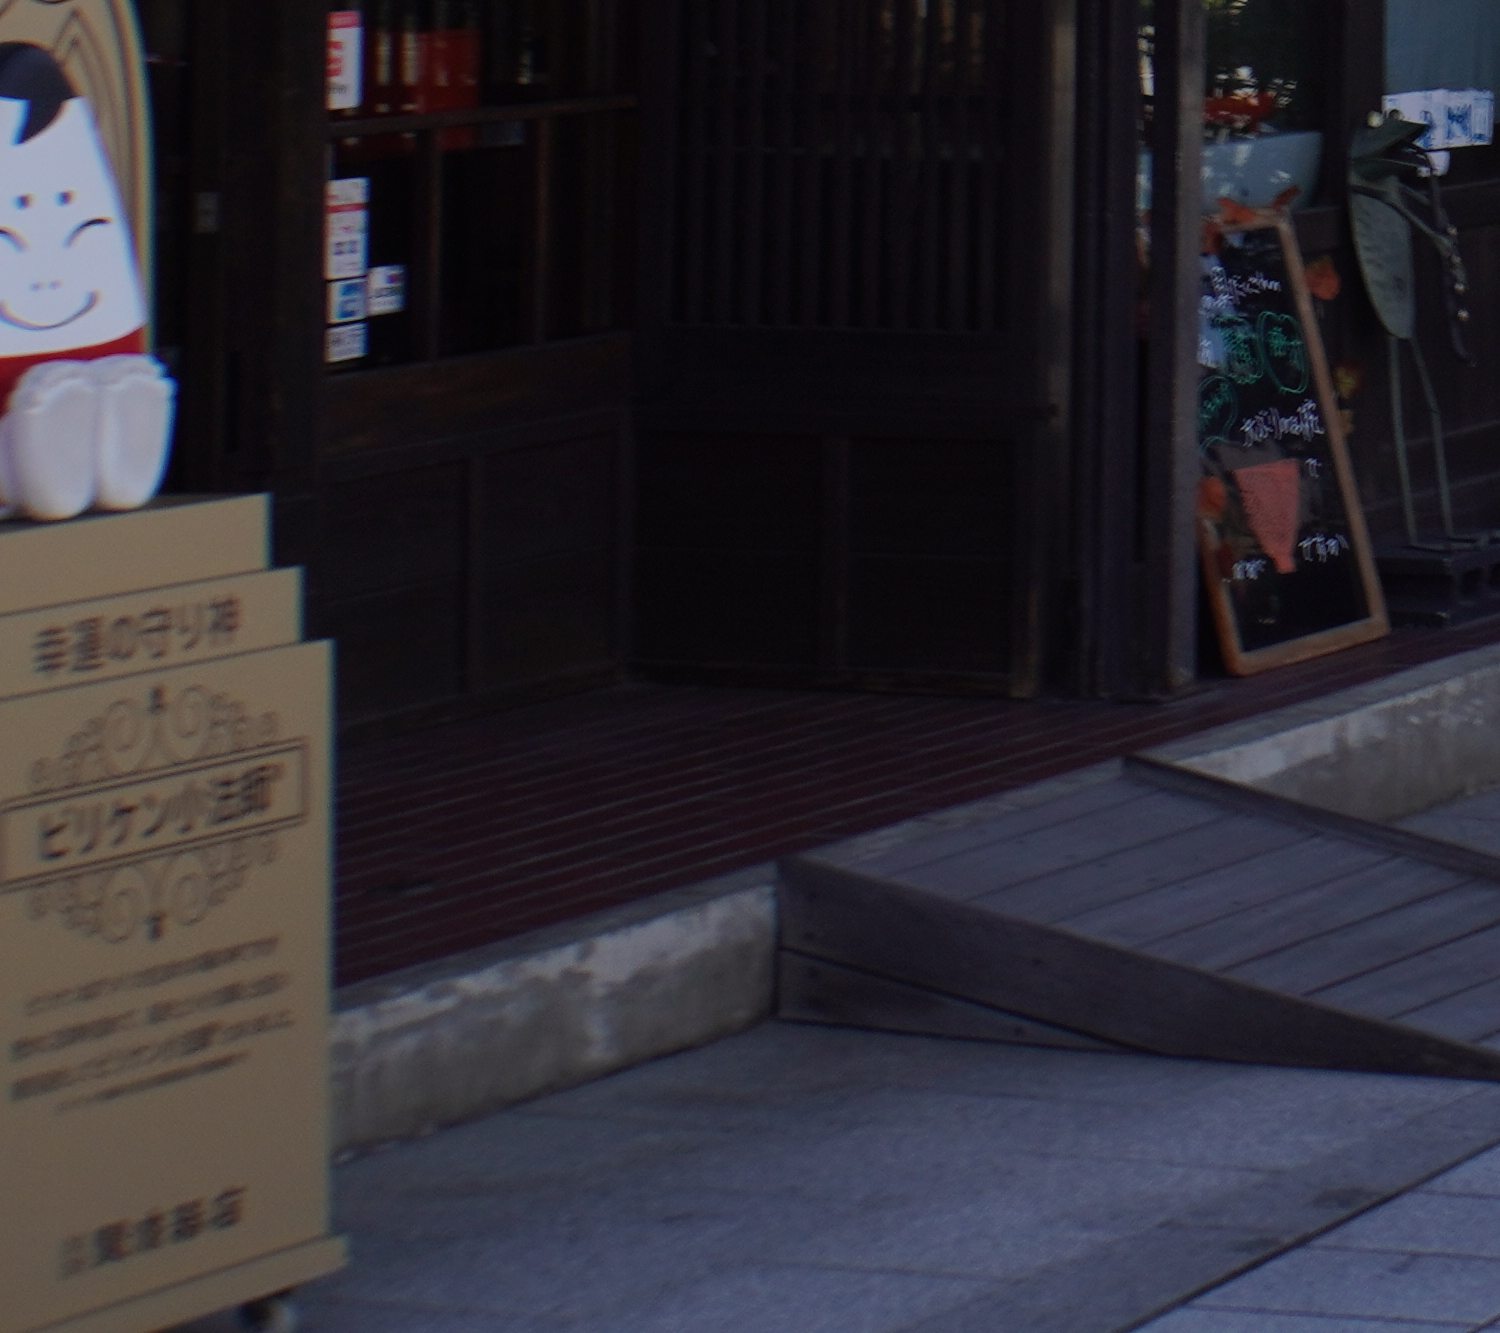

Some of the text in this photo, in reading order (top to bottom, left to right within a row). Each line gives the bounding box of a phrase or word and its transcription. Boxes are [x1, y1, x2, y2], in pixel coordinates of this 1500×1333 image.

[34, 596, 241, 673] 幸運の守り神
